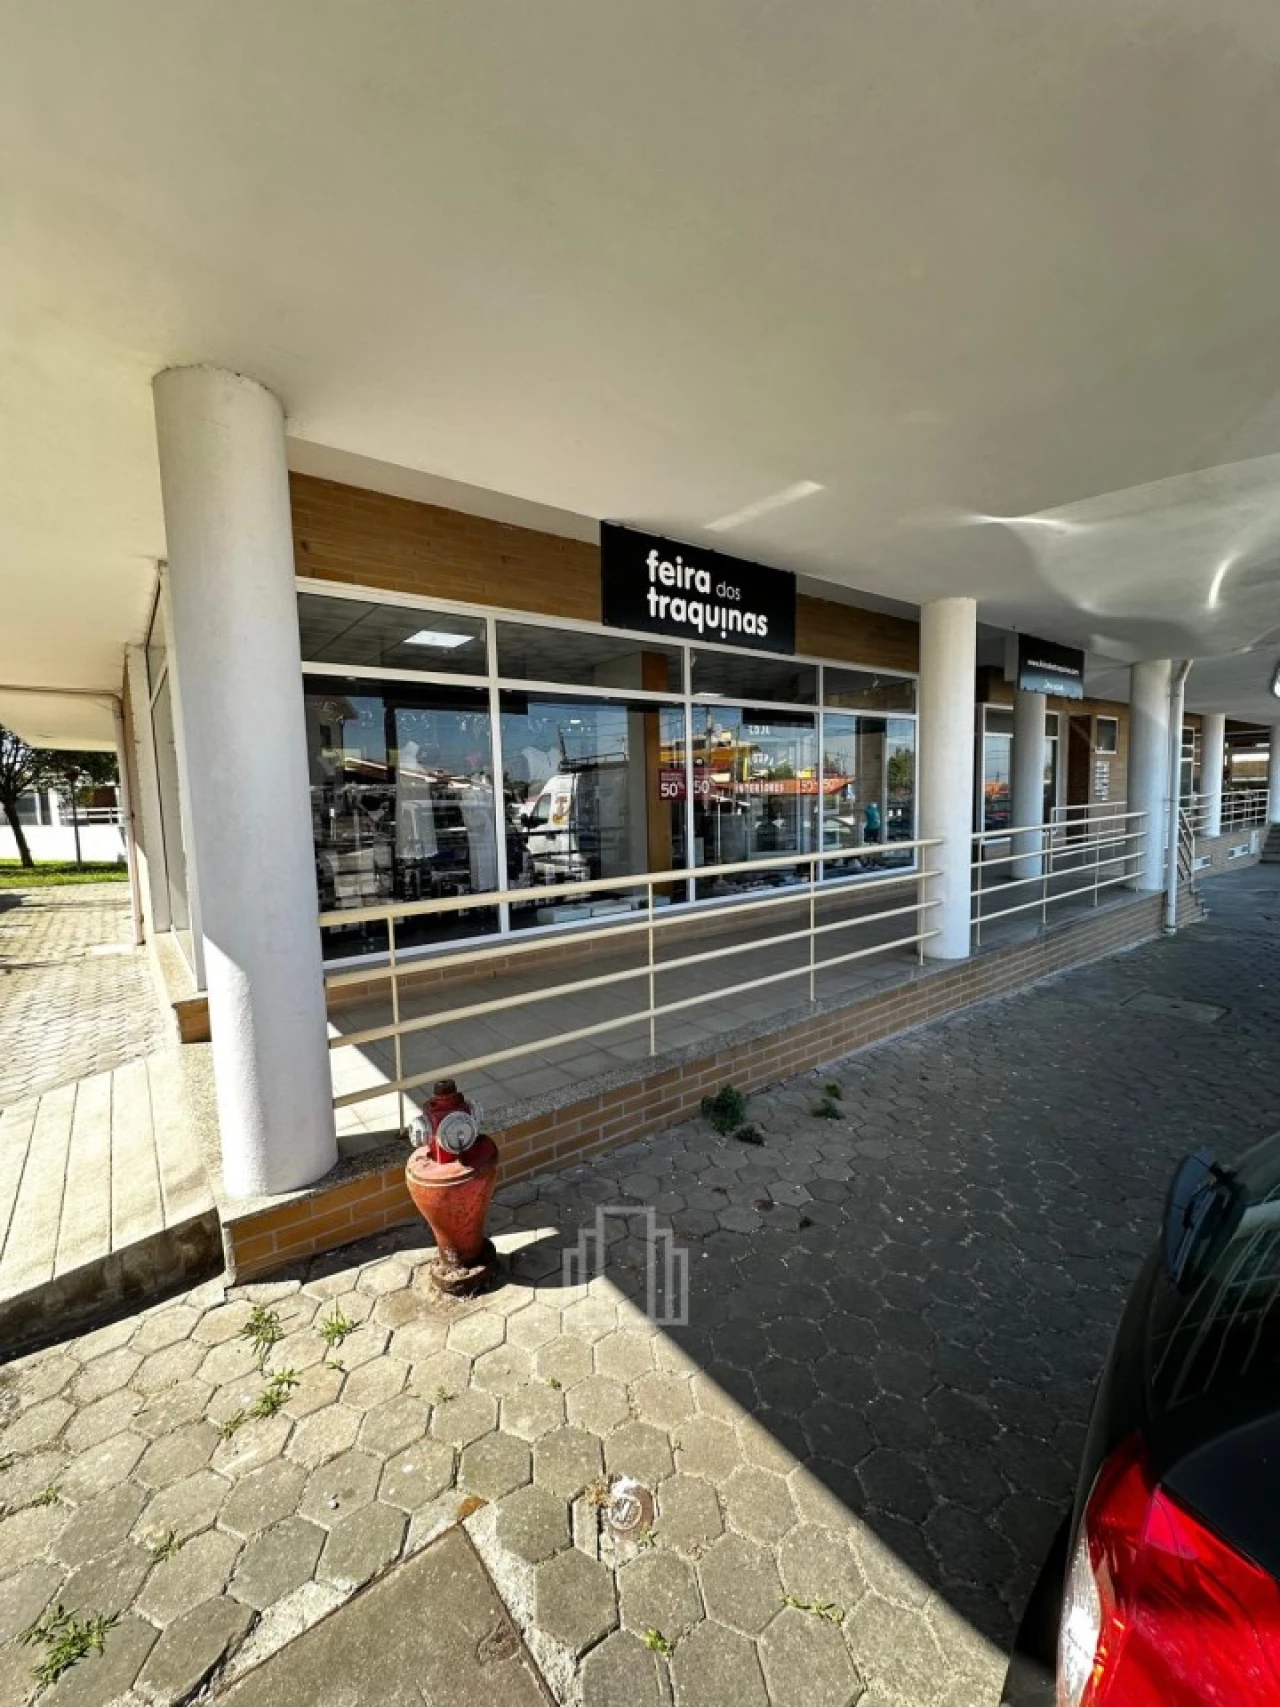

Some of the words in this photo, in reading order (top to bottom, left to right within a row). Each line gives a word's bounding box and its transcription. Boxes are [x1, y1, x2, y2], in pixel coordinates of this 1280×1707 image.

[647, 549, 711, 594] feira
[716, 581, 741, 601] dos
[647, 587, 769, 639] traquinas
